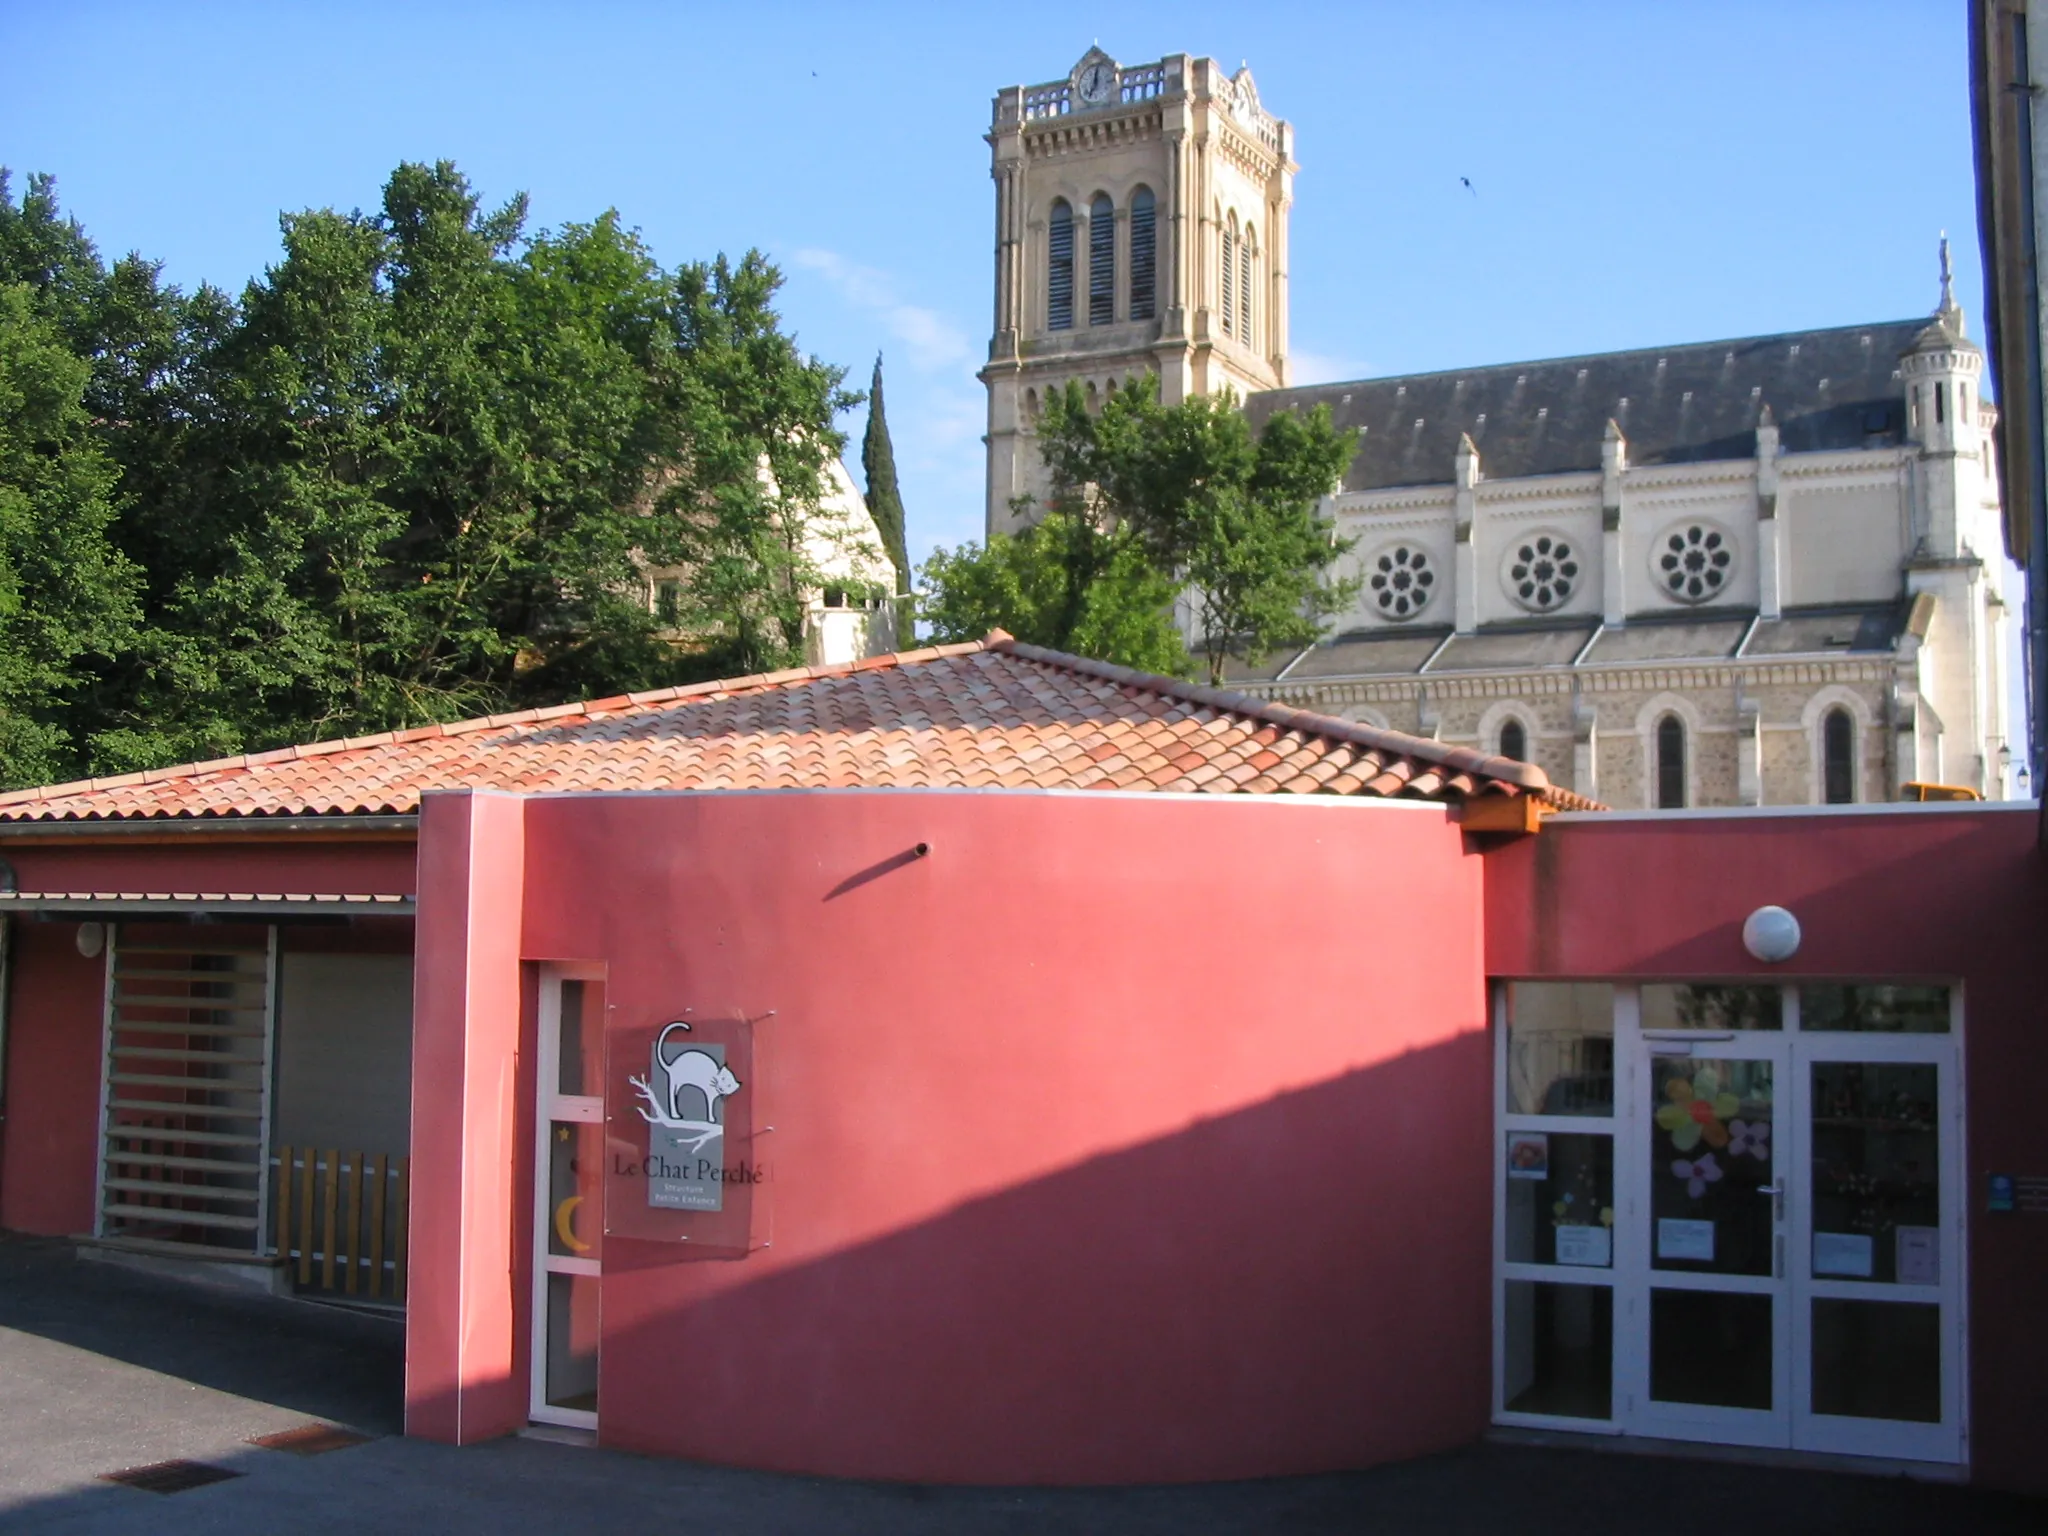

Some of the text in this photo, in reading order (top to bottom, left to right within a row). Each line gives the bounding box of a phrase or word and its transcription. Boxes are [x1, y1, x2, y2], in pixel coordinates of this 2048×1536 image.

[614, 1154, 763, 1184] Le Chat Perché
[664, 1183, 704, 1194] Structure
[682, 1195, 716, 1205] Enfance
